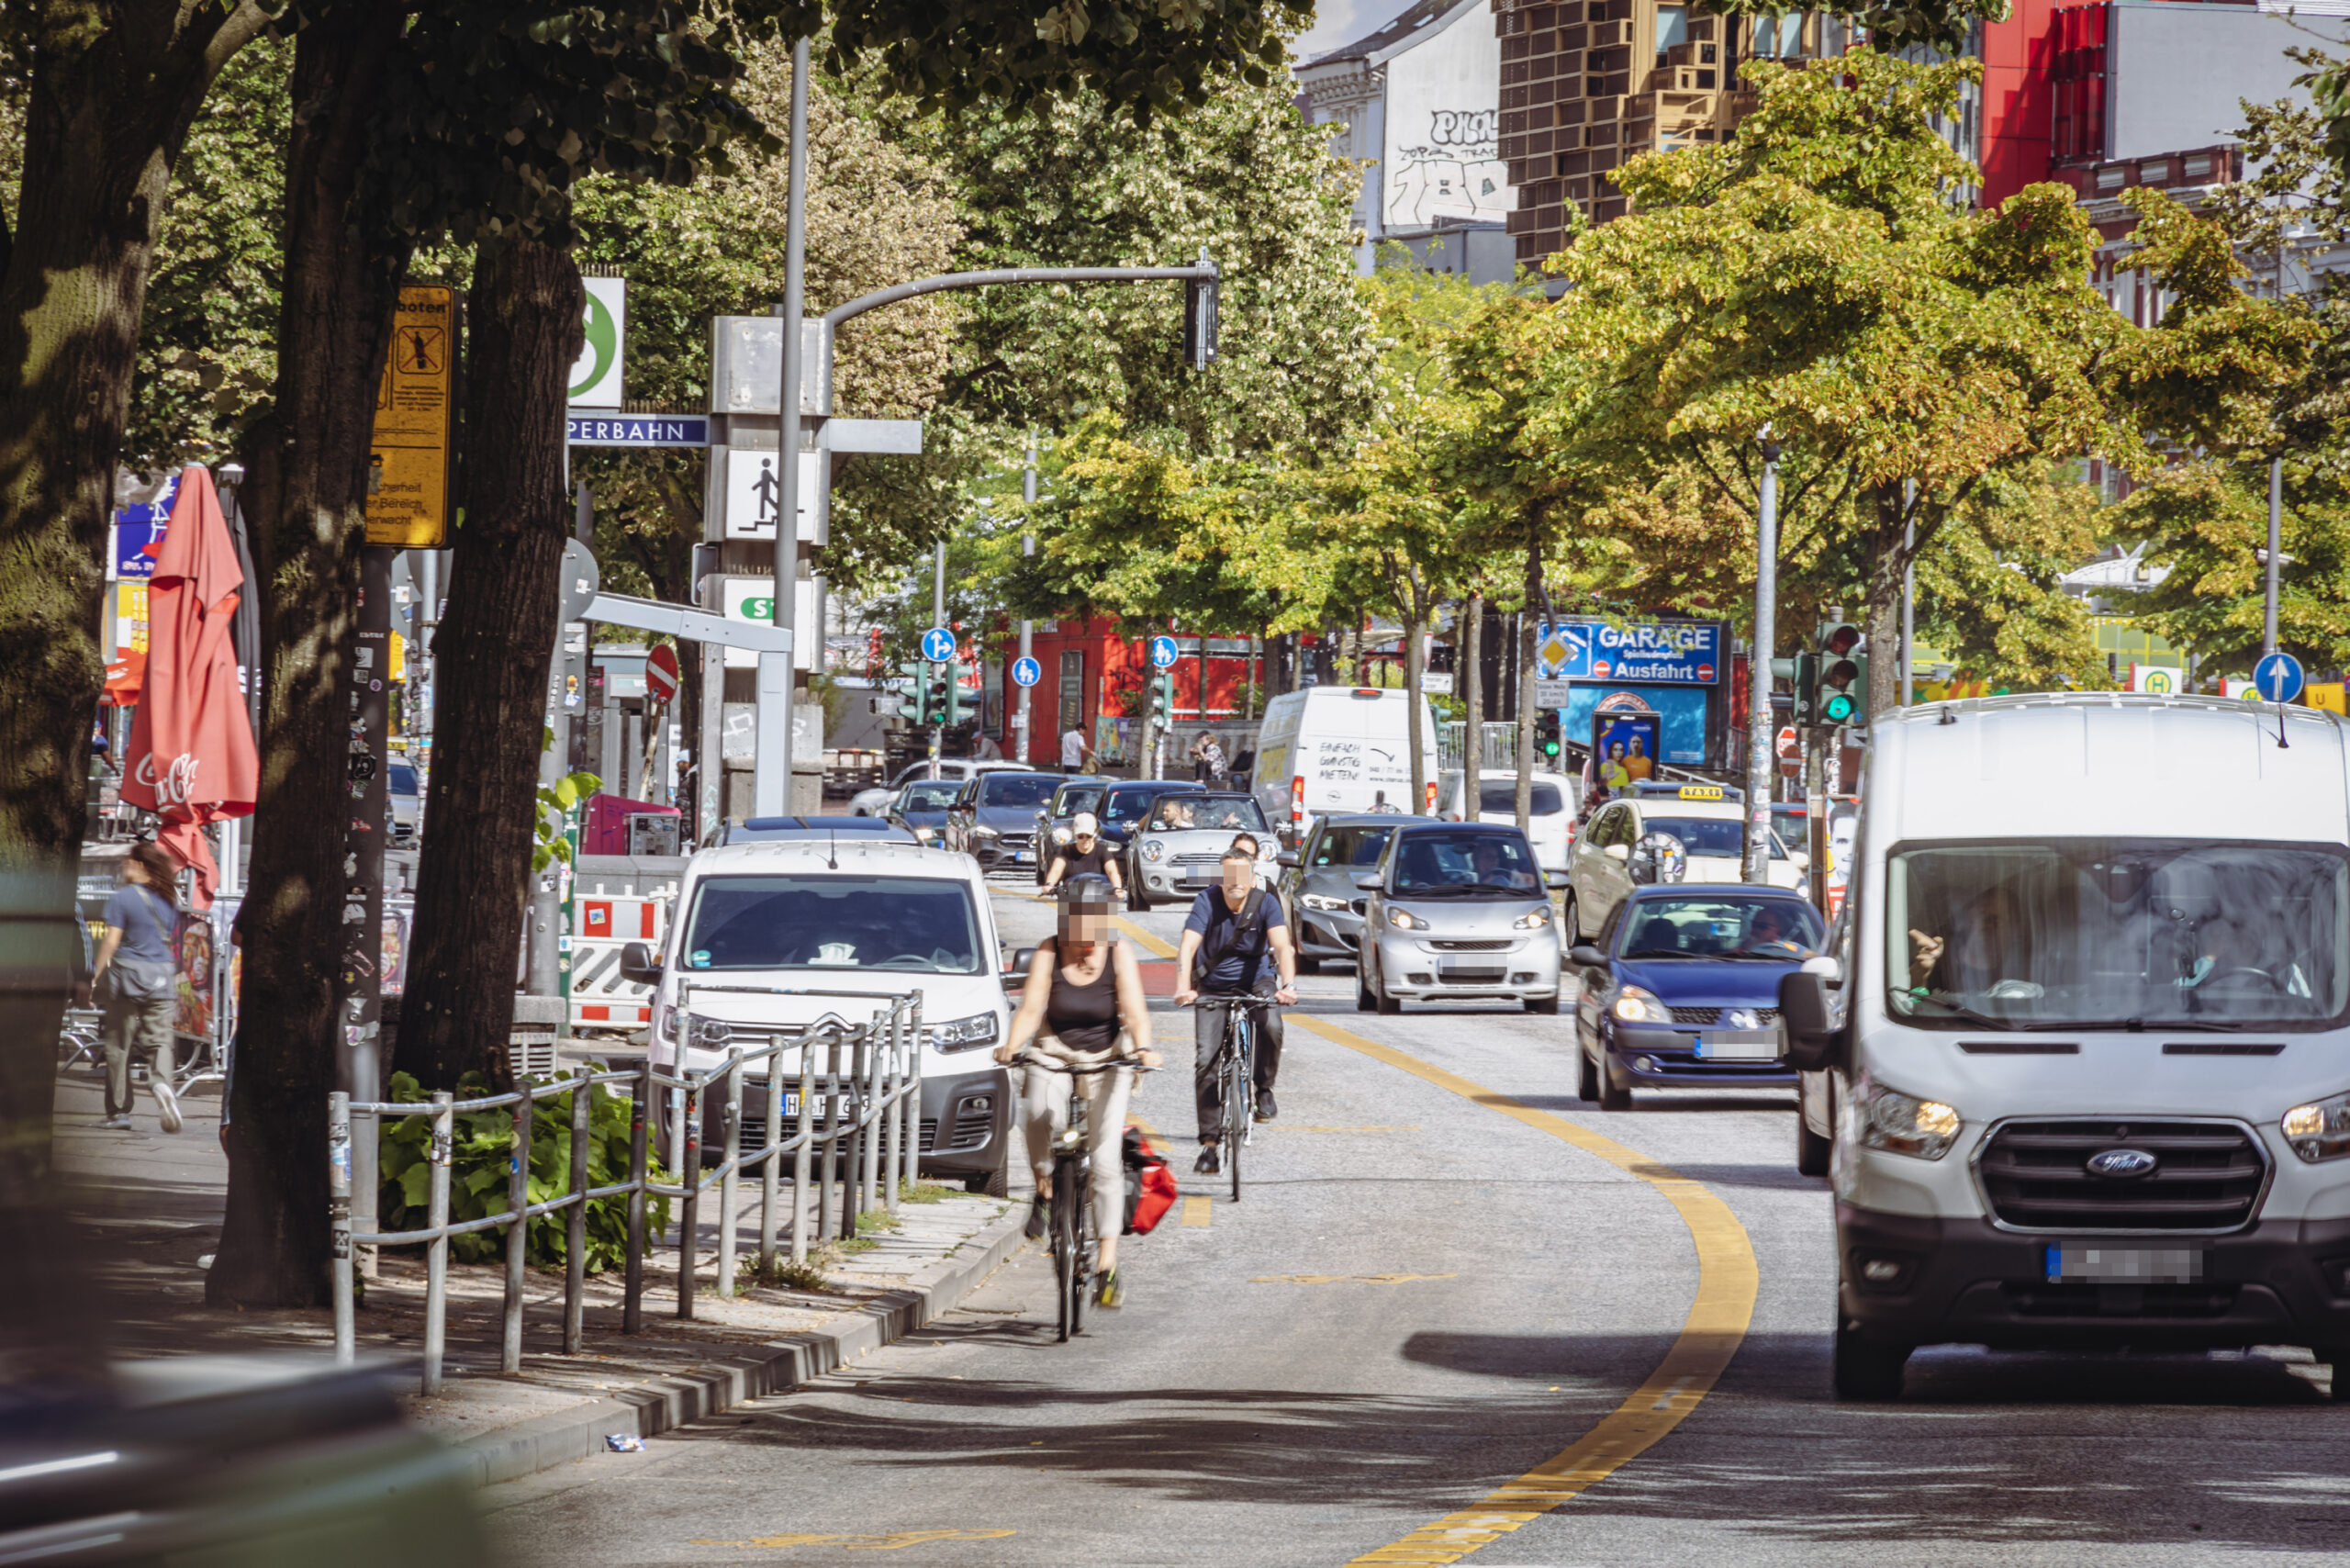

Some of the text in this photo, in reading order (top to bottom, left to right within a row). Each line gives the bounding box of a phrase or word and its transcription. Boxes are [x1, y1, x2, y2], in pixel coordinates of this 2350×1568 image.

[567, 421, 684, 441] PERBAHN
[379, 498, 422, 509] Bereich
[1599, 626, 1711, 650] GARAGE
[1615, 662, 1694, 679] Ausfahrt
[2315, 693, 2325, 705] U
[1684, 789, 1720, 797] TAXI
[788, 1096, 798, 1114] H
